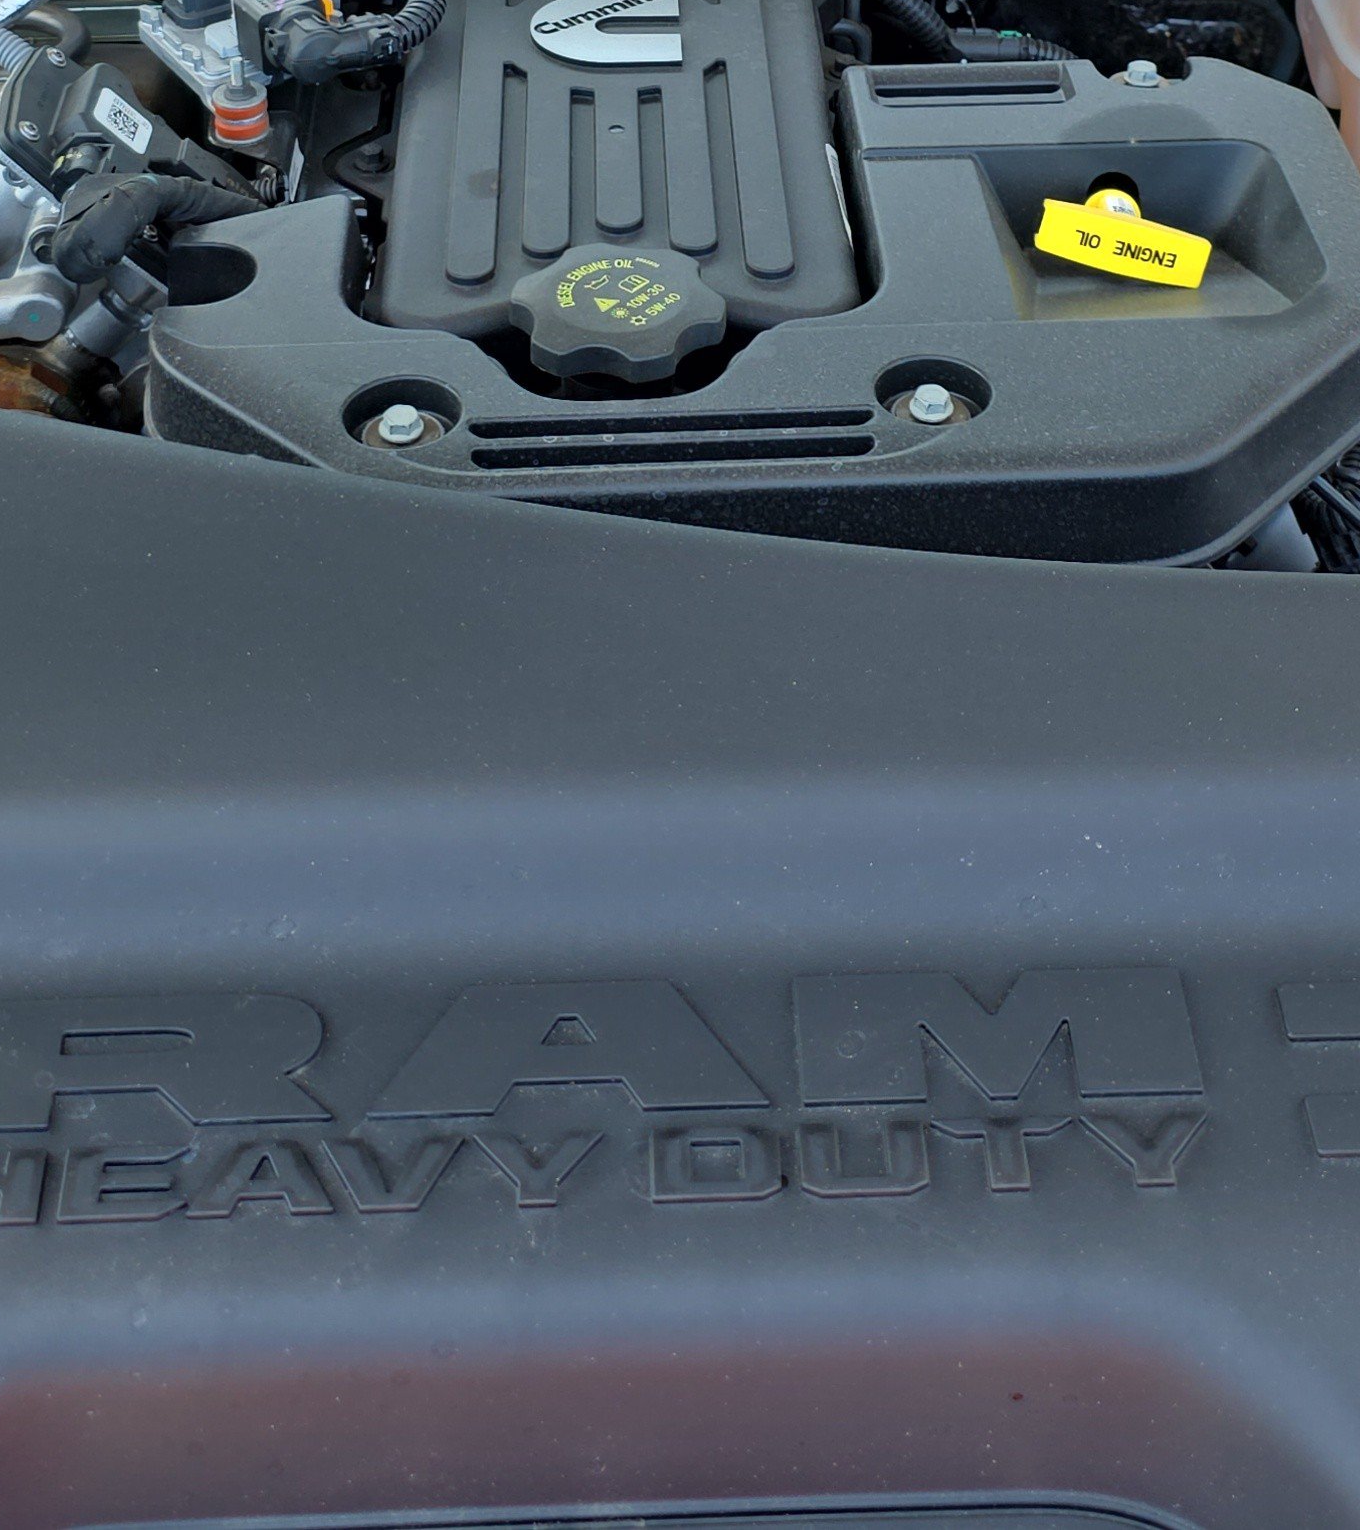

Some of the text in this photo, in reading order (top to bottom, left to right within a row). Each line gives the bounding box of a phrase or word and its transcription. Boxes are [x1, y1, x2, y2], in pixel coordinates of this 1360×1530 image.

[1075, 229, 1178, 269] ENGINE OIL
[556, 281, 576, 308] DIESEL
[566, 259, 612, 281] ENGINE
[613, 258, 635, 269] OIL
[626, 284, 666, 309] 10W-30
[645, 292, 681, 317] 5W-40
[650, 1111, 1210, 1205] DUTY
